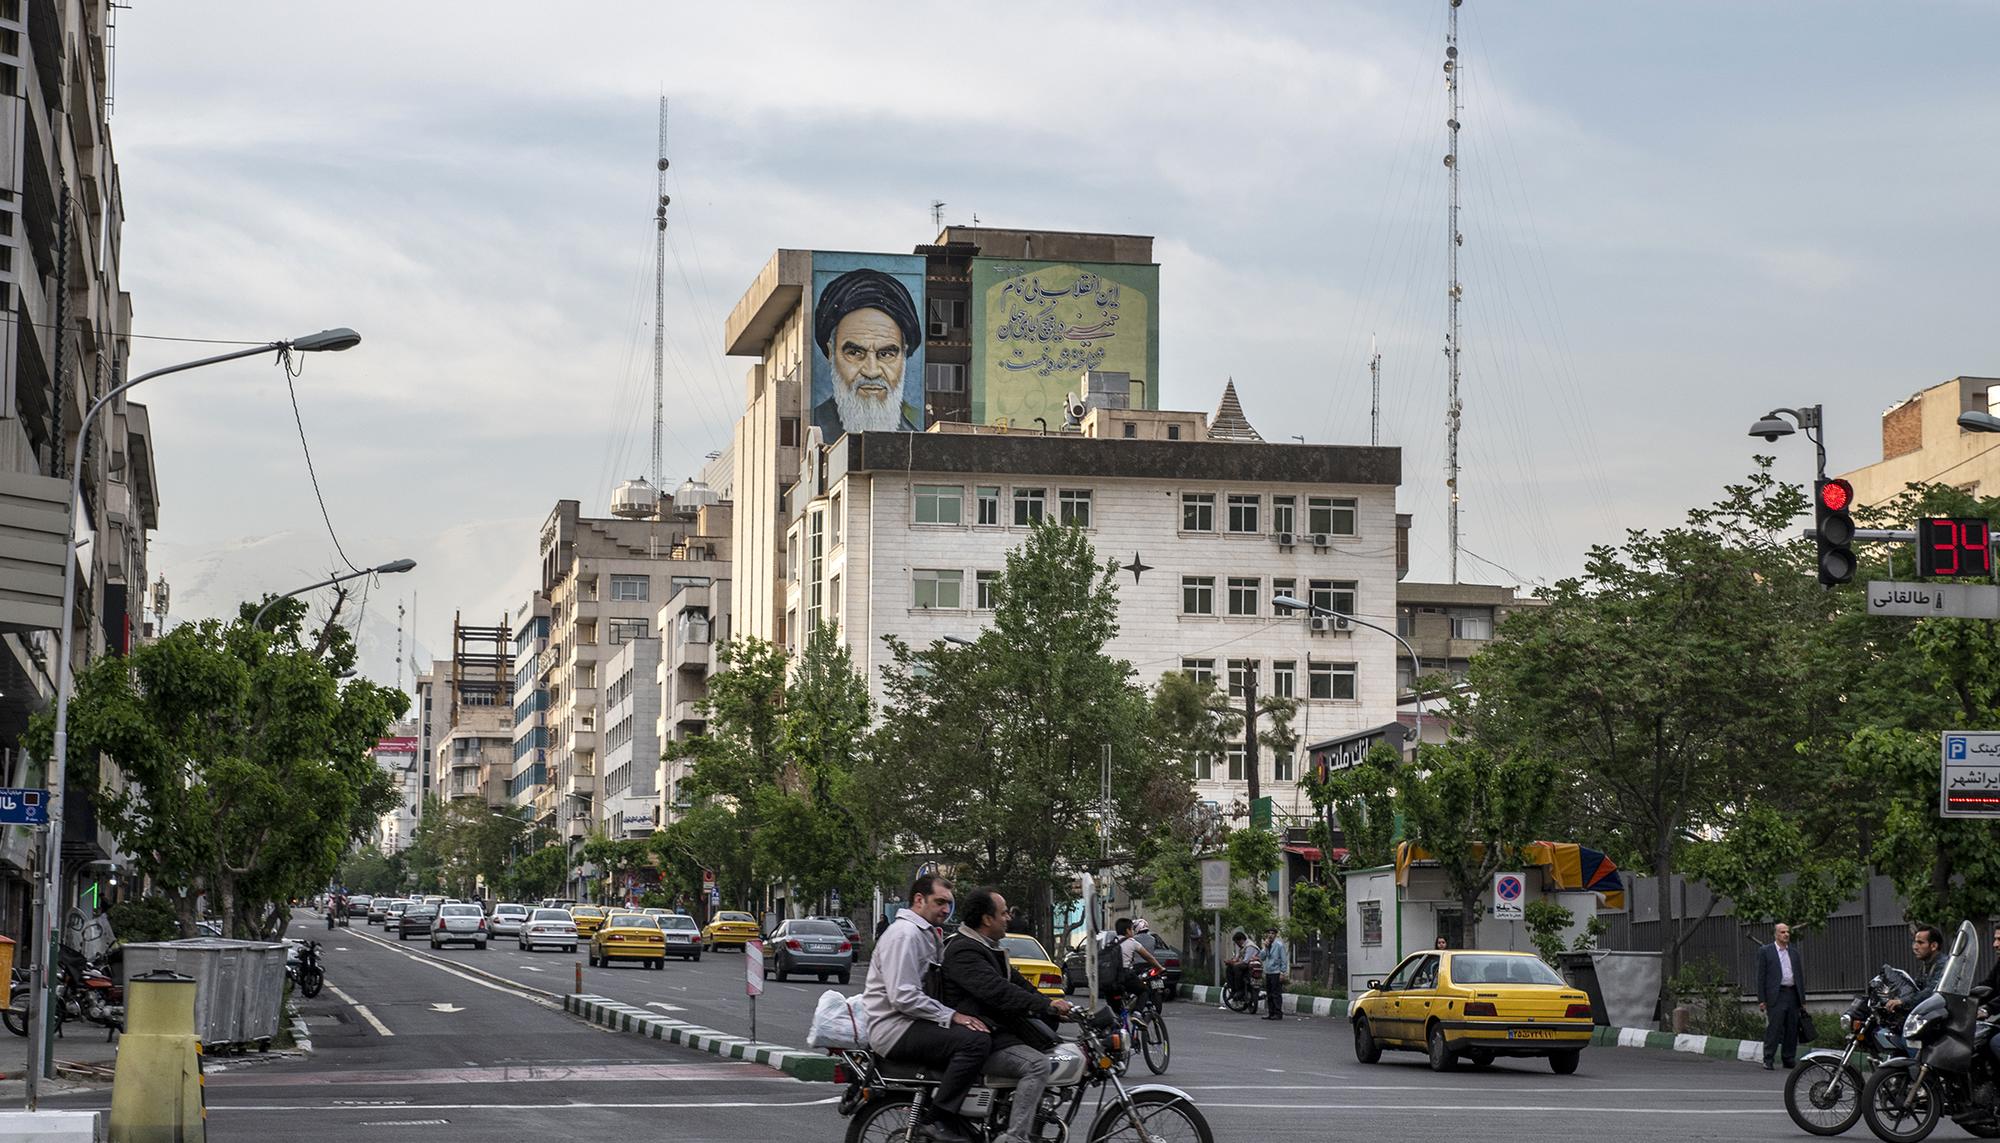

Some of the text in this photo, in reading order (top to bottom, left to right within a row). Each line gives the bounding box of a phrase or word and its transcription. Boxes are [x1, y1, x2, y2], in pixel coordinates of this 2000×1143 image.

[1000, 277, 1026, 313] نام
[1039, 273, 1103, 306] انقلاب
[1095, 282, 1120, 309] این
[1063, 310, 1120, 348] خمینی
[1932, 520, 1990, 575] 34
[1873, 591, 1930, 608] طالقانی
[1329, 744, 1350, 771] ملت
